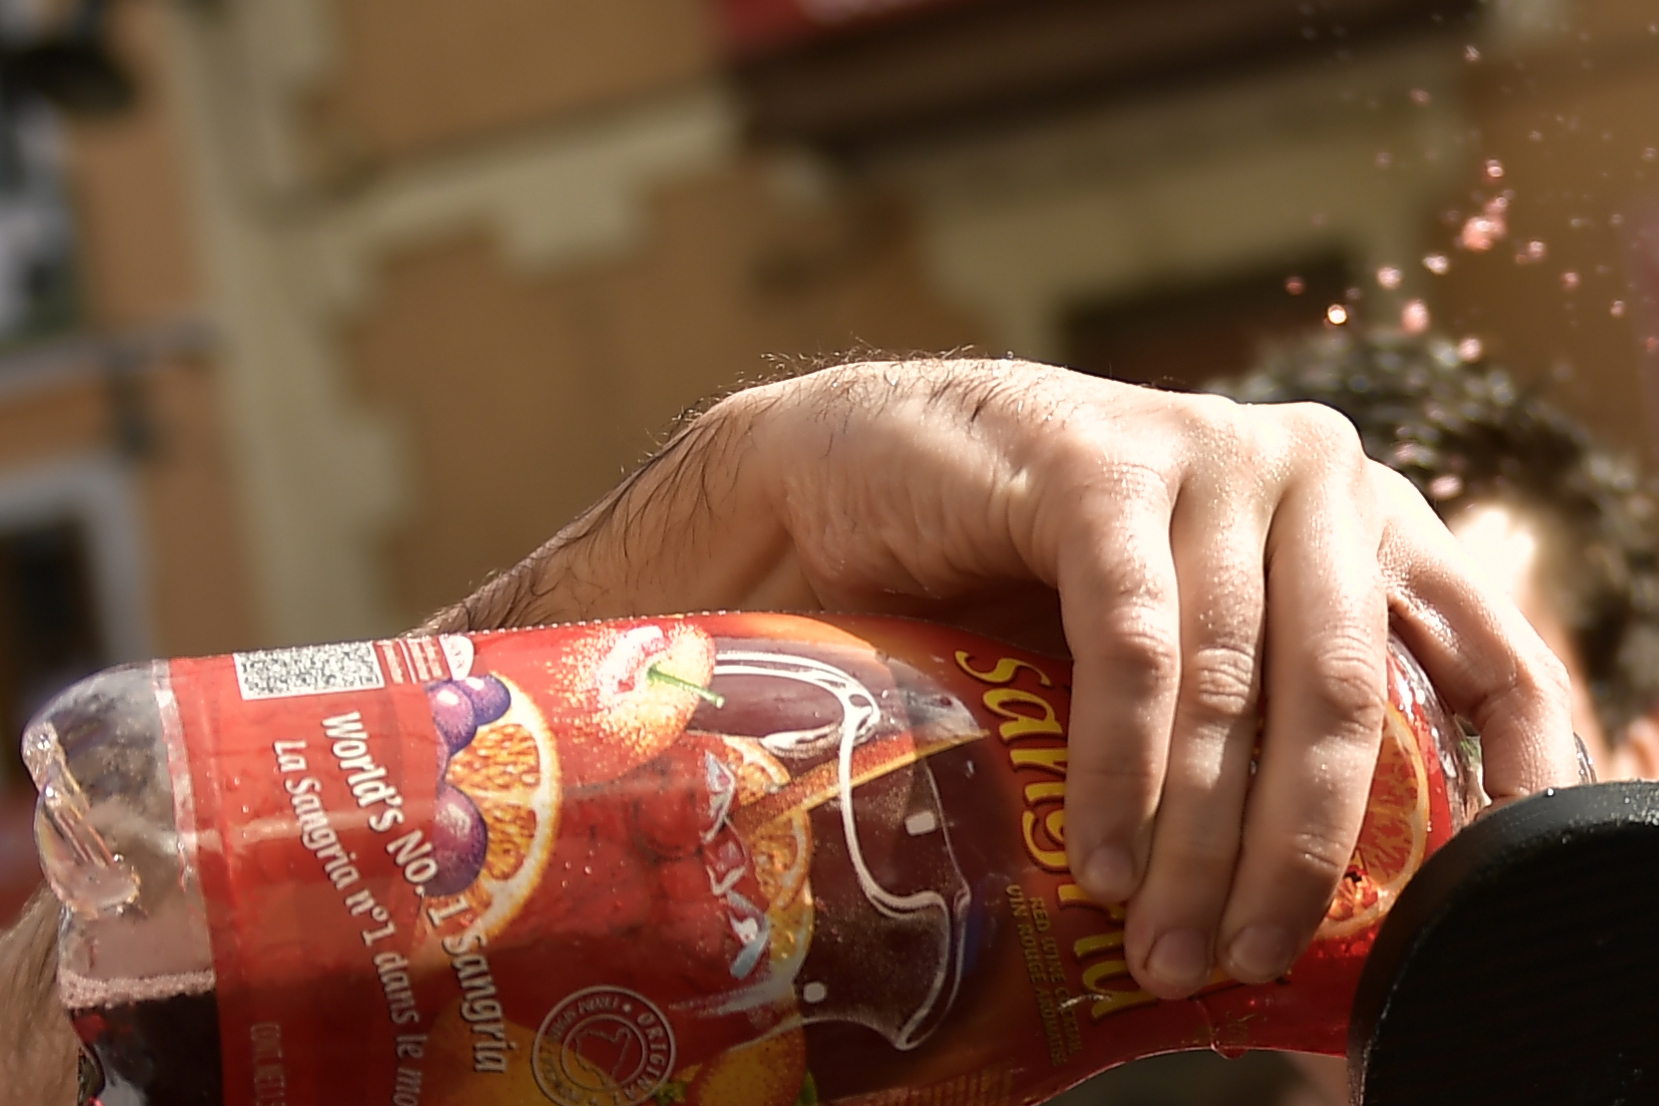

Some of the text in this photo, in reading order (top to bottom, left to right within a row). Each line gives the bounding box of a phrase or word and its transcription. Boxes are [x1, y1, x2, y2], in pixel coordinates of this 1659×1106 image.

[273, 740, 308, 773] La
[285, 776, 361, 892] Sangria
[321, 710, 518, 1074] World's No. 1 Sangria
[1018, 924, 1048, 984] ROUGE
[1029, 897, 1051, 932] RED
[1042, 937, 1067, 983] WINE
[373, 952, 420, 1025] dans
[396, 1034, 428, 1060] le
